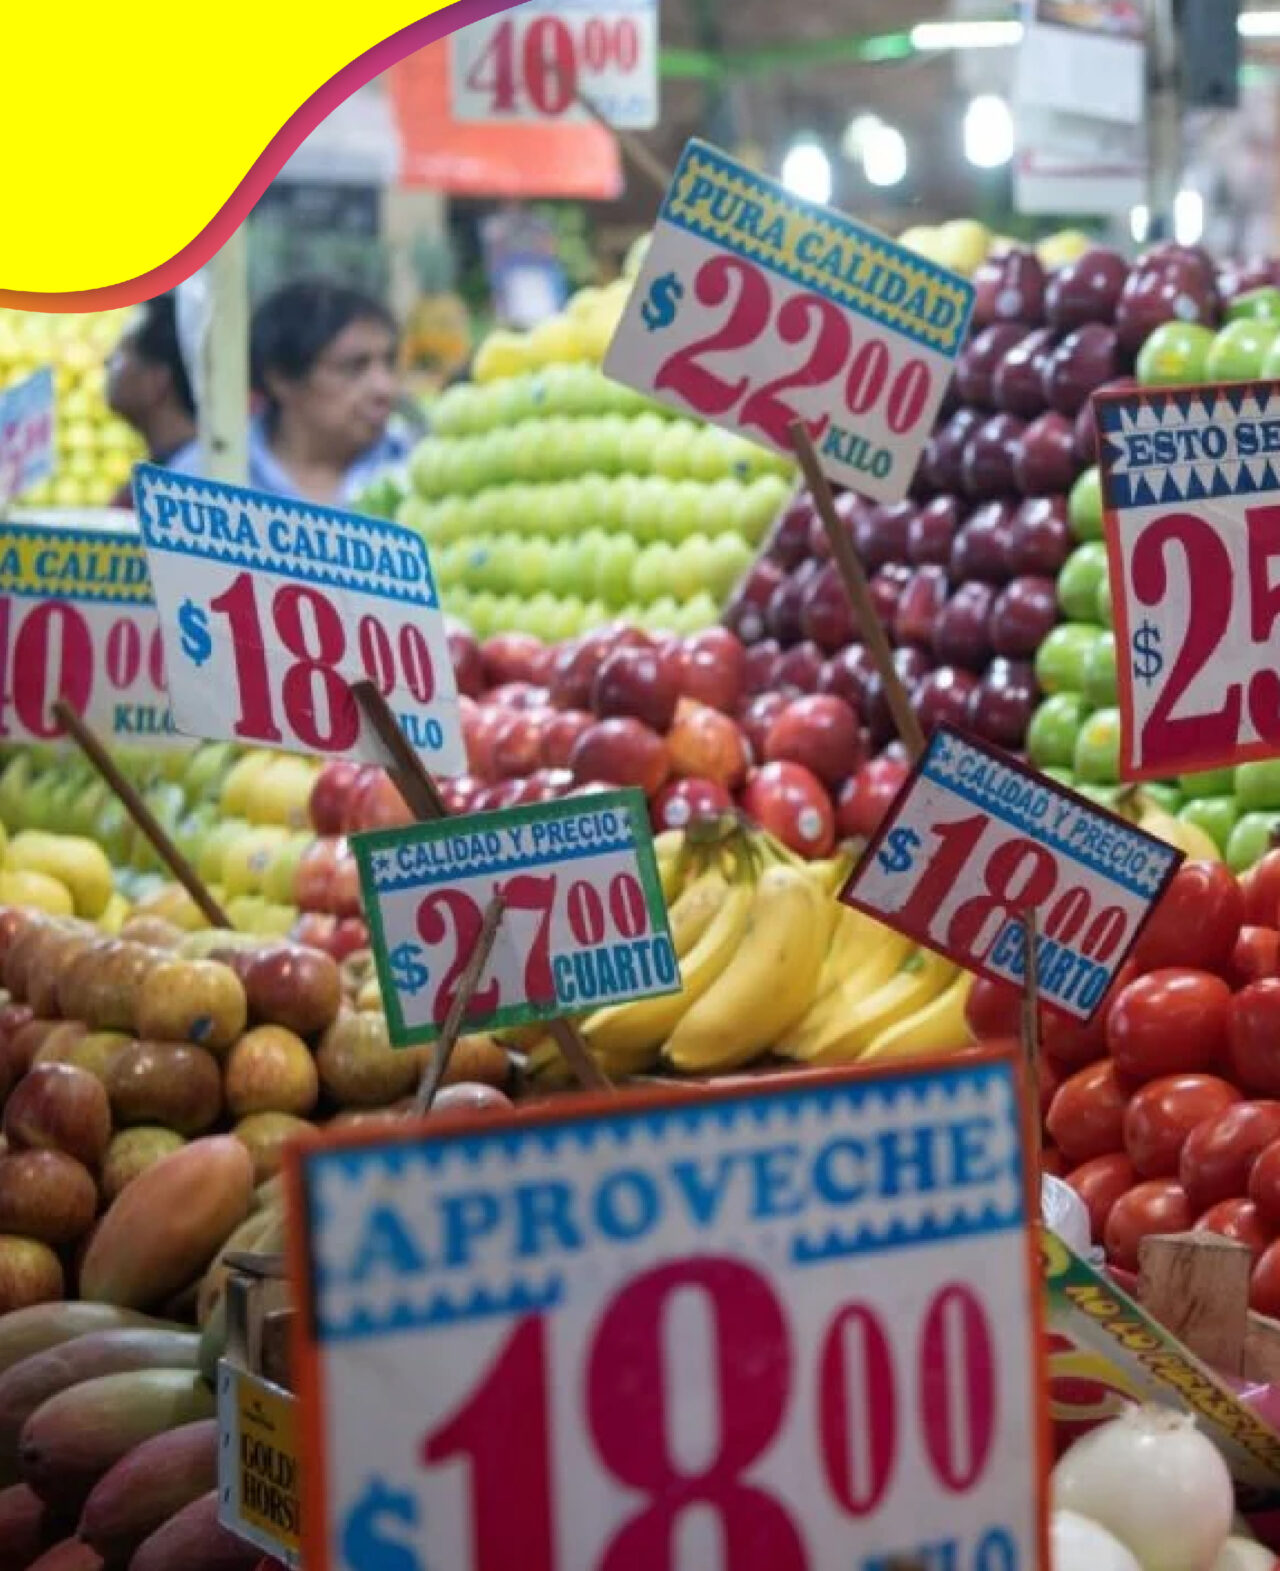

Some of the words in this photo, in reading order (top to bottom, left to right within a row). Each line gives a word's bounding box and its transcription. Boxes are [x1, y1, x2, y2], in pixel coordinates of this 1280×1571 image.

[684, 174, 786, 244] PURA
[795, 228, 958, 330] CALIDAD
[822, 425, 894, 479] KILO
[1126, 424, 1228, 467] ESTO
[35, 551, 149, 585] CALID
[155, 493, 260, 550] PURA
[268, 523, 423, 583] CALIDAD
[396, 833, 500, 873] CALIDAD
[503, 828, 526, 852] Y
[531, 811, 618, 848] PRECIO
[956, 753, 1047, 818] CALIDAD
[1054, 806, 1072, 832] Y
[1071, 815, 1149, 877] PRECIO
[553, 936, 677, 1004] CUARTO
[349, 1115, 1000, 1282] APROVECHE
